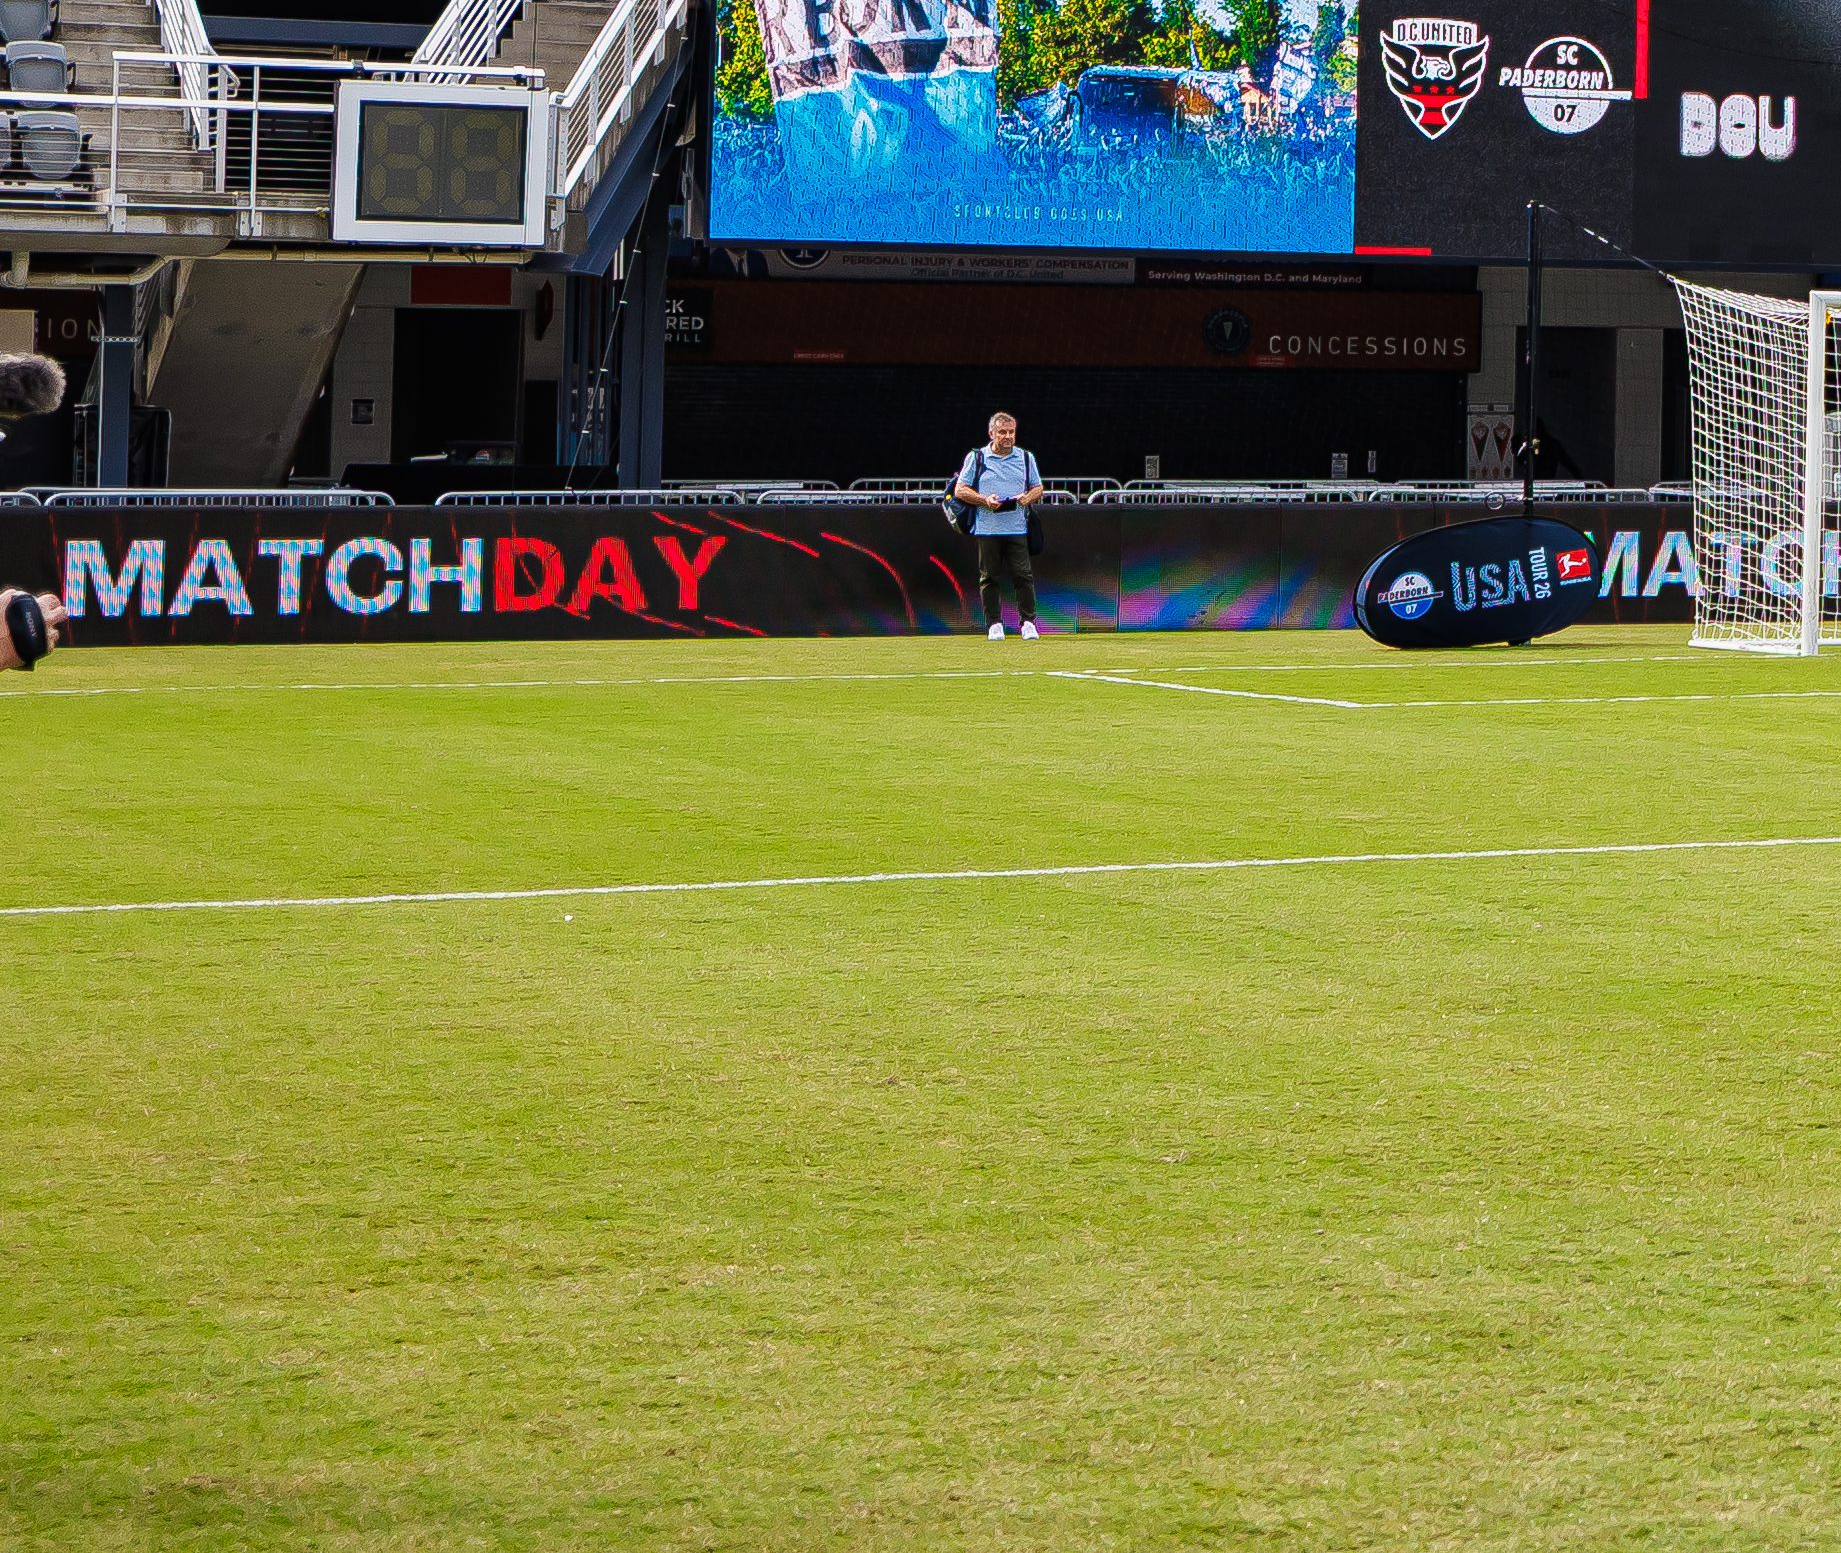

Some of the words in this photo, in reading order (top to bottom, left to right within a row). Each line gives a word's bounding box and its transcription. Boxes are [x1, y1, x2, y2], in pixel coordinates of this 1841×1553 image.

[1556, 44, 1579, 65] SC
[1499, 67, 1605, 90] PADERBORN
[1553, 103, 1577, 122] 07
[842, 254, 908, 266] PERSONAL
[910, 256, 954, 267] INJURY
[1036, 258, 1130, 271] COMPENSATION
[1148, 269, 1191, 283] Serving
[1194, 270, 1261, 284] Washington
[1263, 272, 1285, 283] D.C.
[1288, 271, 1310, 283] and
[1312, 272, 1362, 285] Maryland
[1268, 335, 1467, 357] CONCESSIONS
[1528, 546, 1549, 580] TOUR
[64, 535, 727, 618] MATCHDAY
[1404, 573, 1416, 586] SC
[1450, 558, 1531, 613] USA
[1534, 581, 1551, 599] 26
[1405, 603, 1417, 615] 07
